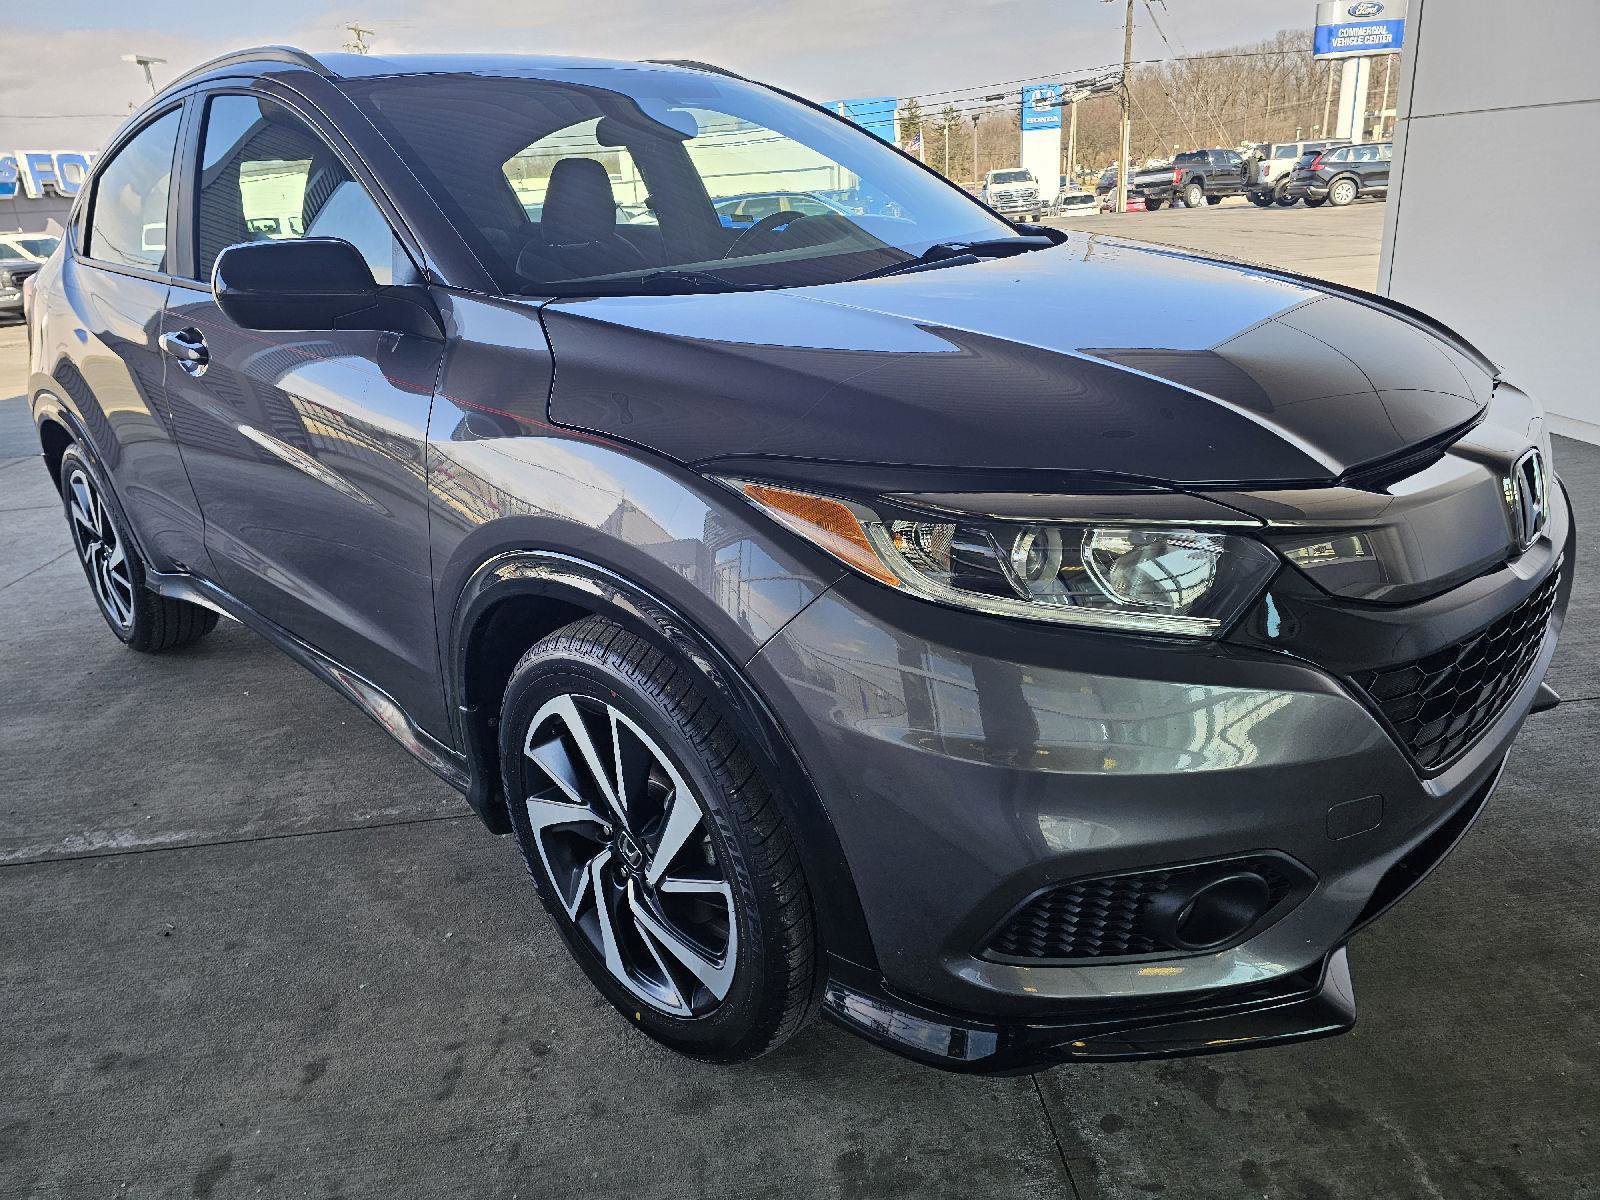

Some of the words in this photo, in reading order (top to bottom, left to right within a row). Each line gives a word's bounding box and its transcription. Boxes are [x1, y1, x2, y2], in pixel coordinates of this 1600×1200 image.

[1339, 26, 1387, 36] COMMERCIAL
[1332, 36, 1364, 47] VEHICLE
[1364, 34, 1392, 44] CENTER
[1026, 116, 1059, 124] HONDA
